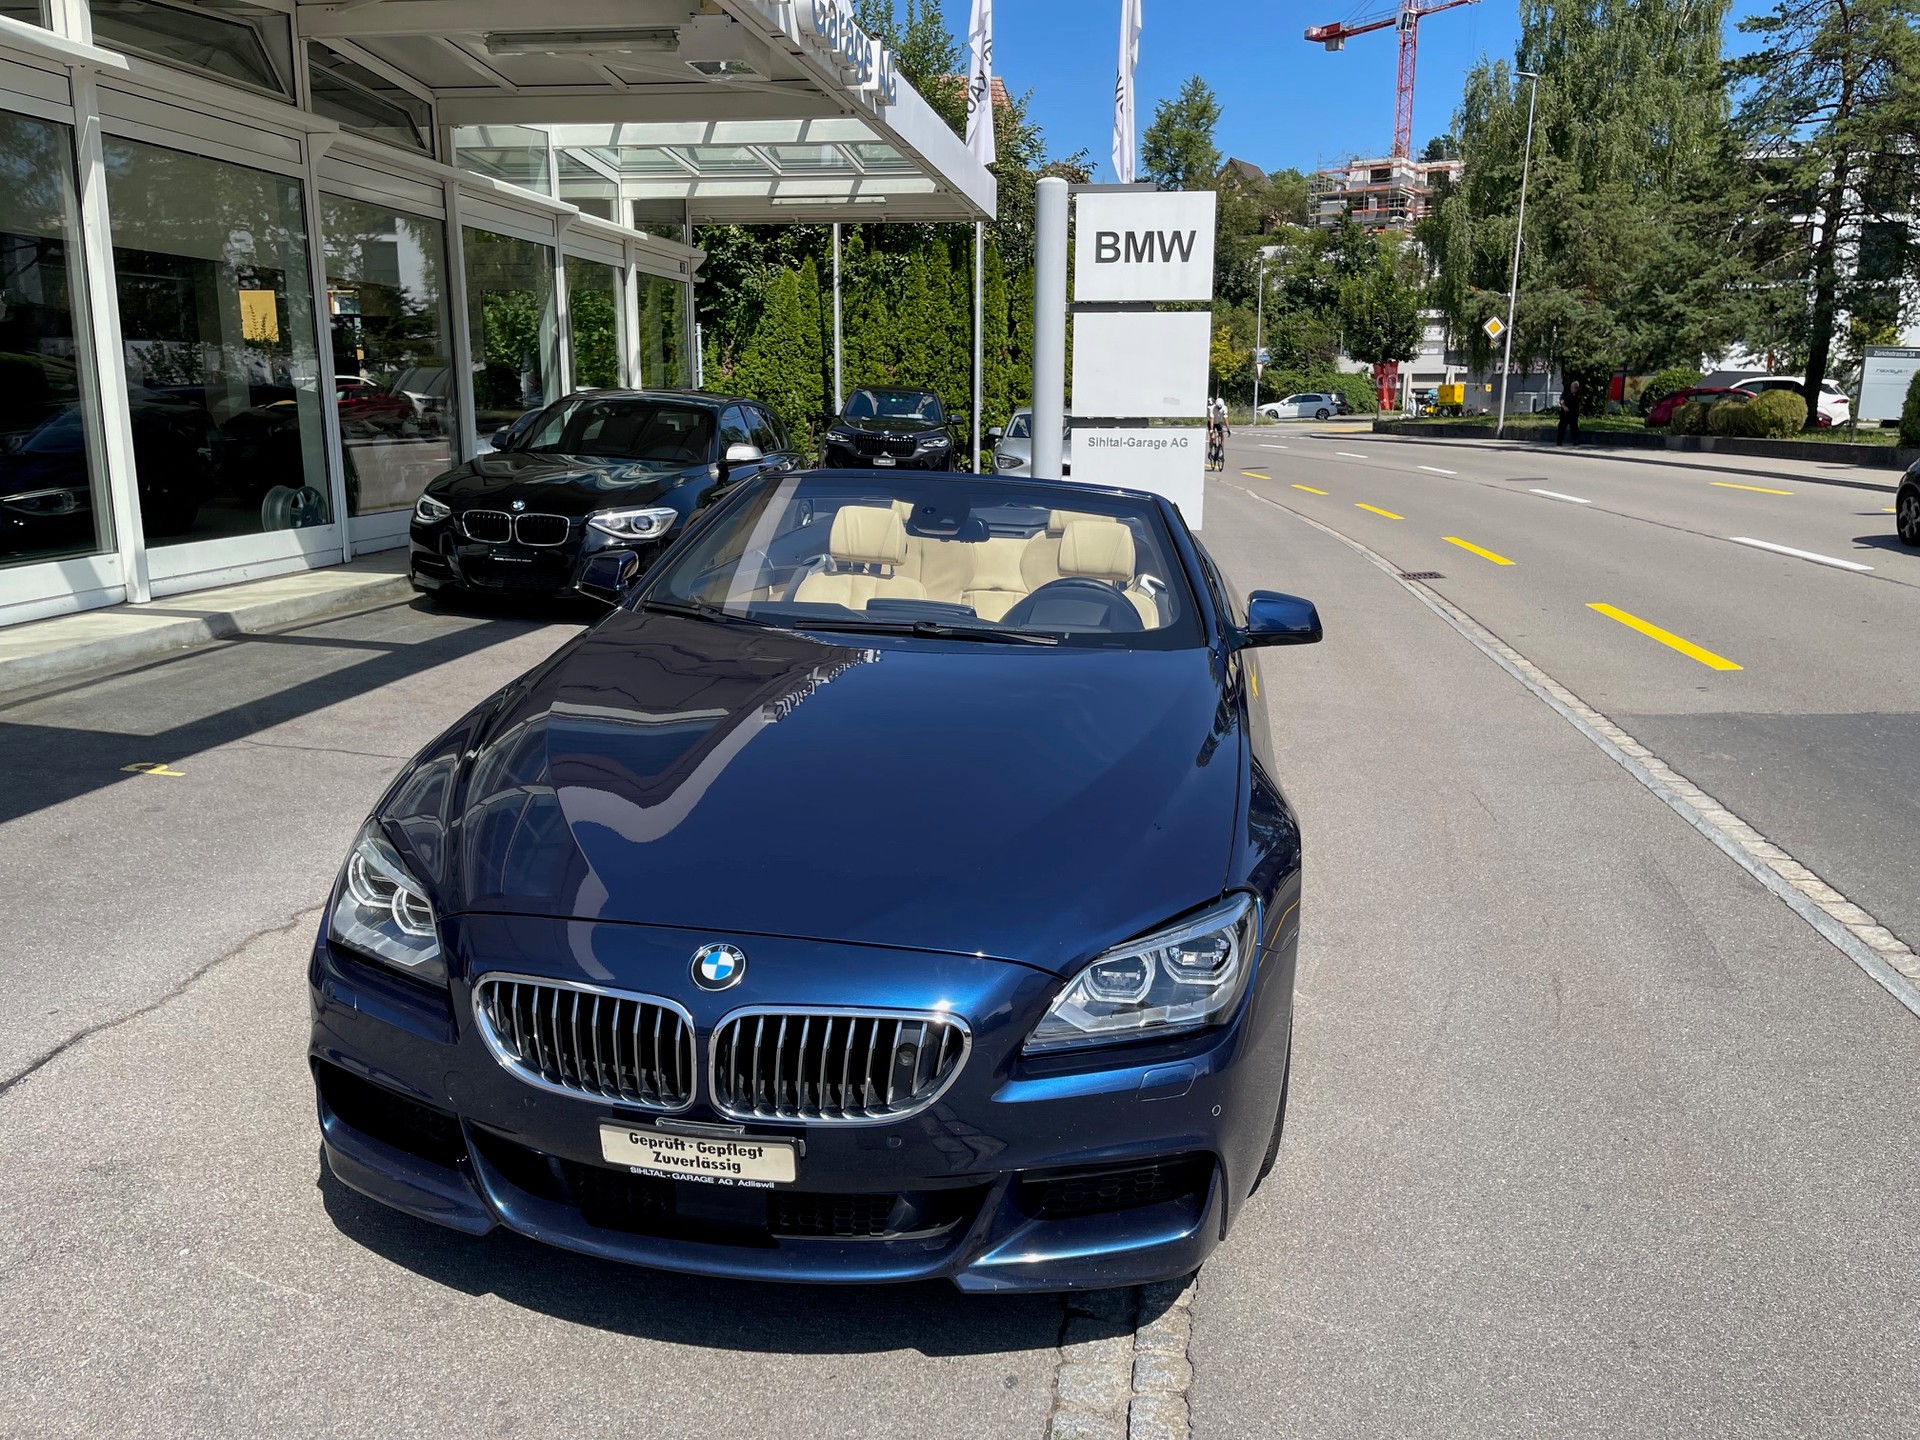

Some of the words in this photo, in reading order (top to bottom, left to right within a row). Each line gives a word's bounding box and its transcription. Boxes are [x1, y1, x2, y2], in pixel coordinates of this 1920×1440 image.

[1095, 230, 1197, 263] BMW
[1088, 437, 1168, 450] Sihltal-Garage
[1170, 437, 1189, 448] AG
[629, 1132, 686, 1151] Geprüft
[696, 1141, 764, 1160] Gepflegt
[652, 1151, 741, 1174] Zuverlässig
[718, 1177, 734, 1186] AG
[737, 1179, 775, 1189] Adliswil
